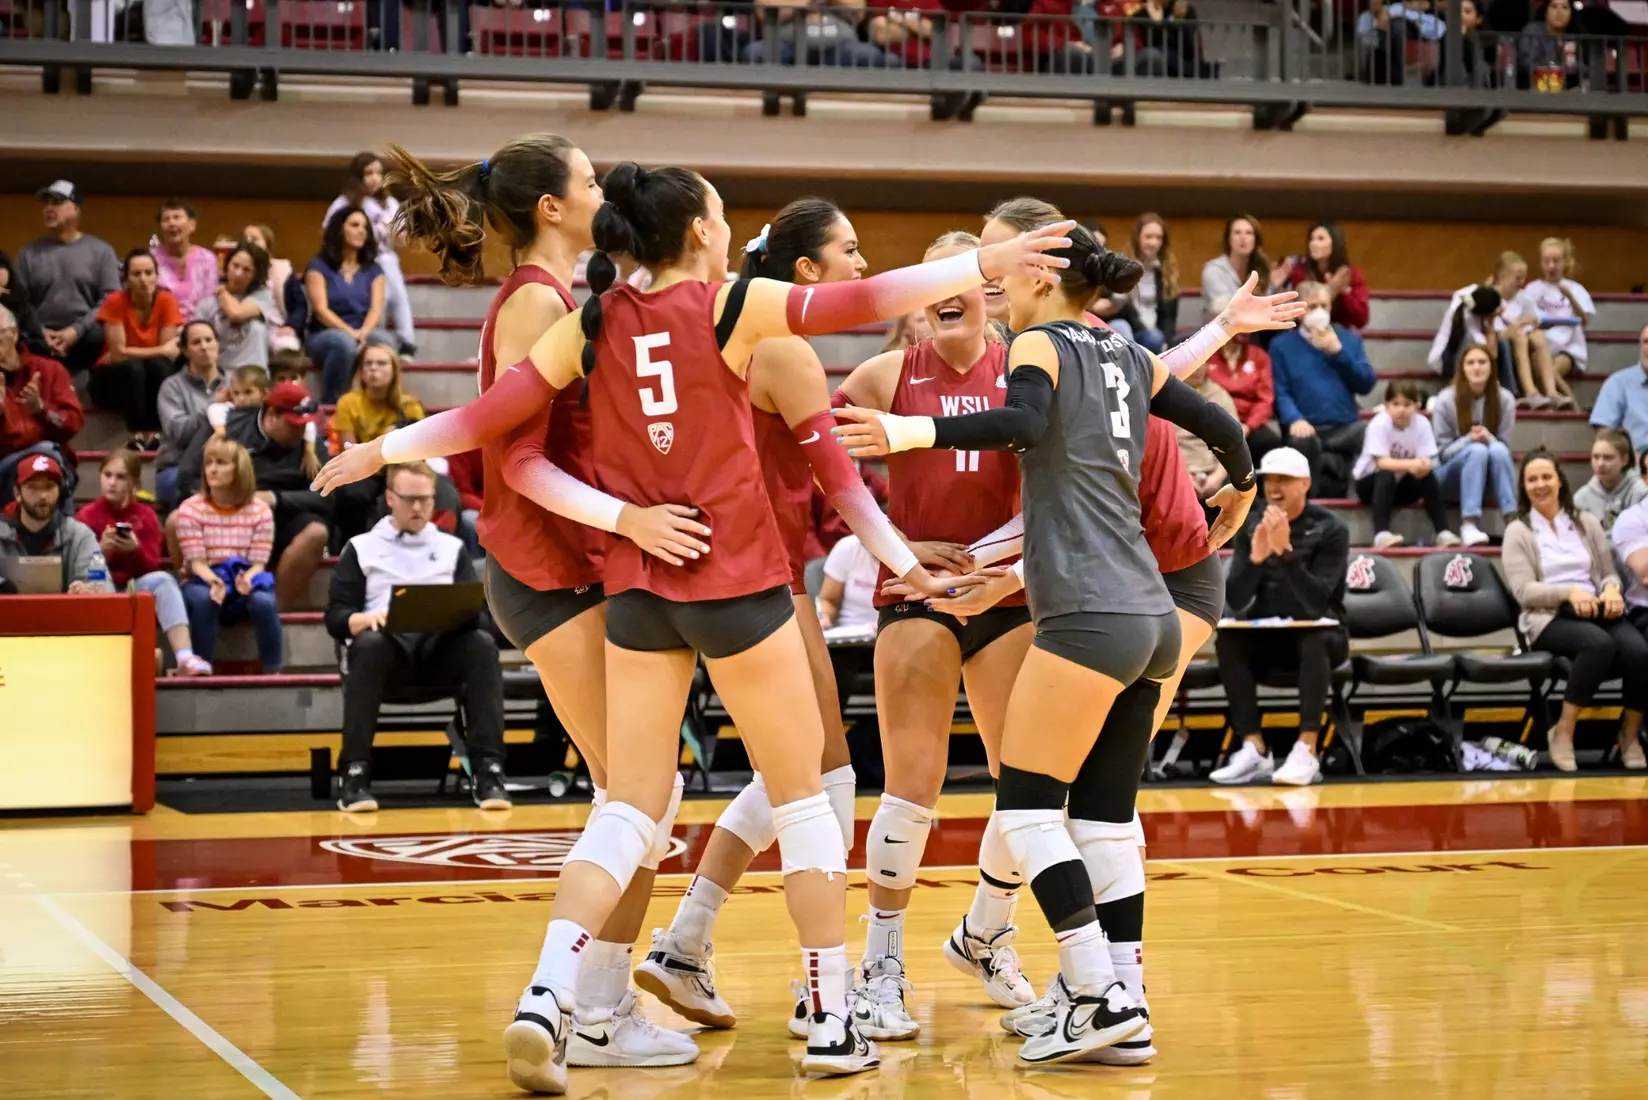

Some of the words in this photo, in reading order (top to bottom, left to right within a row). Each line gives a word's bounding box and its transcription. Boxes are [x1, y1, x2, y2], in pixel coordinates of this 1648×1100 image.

[631, 331, 678, 416] 5
[1100, 362, 1131, 438] 3
[939, 395, 990, 417] WSU
[158, 891, 557, 912] Marcia
[1226, 861, 1551, 877] Court
